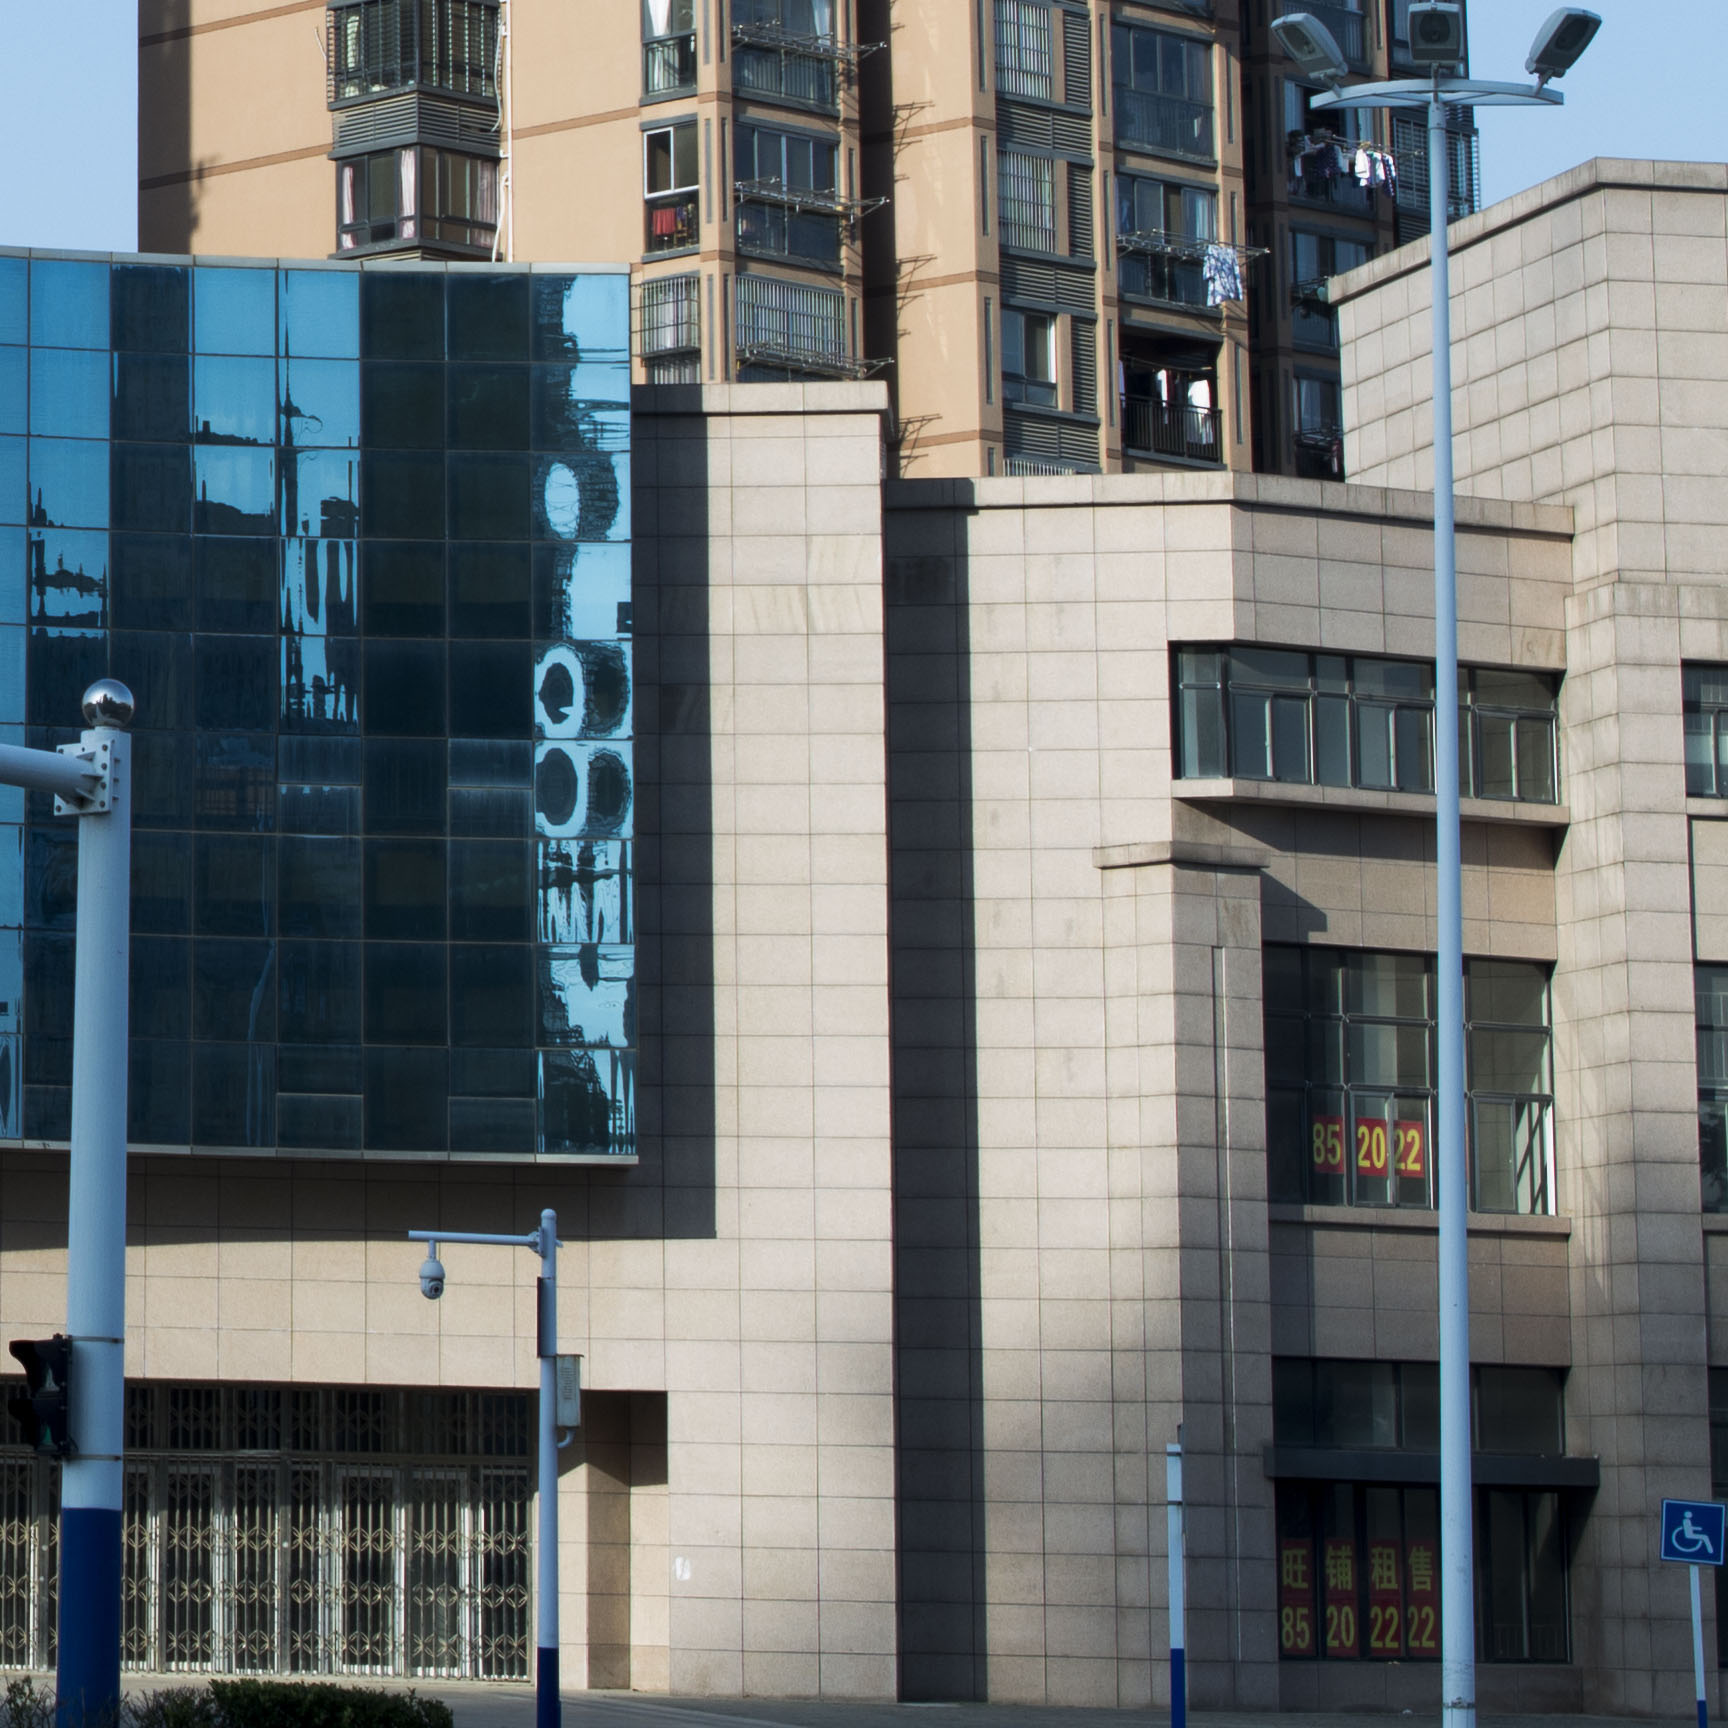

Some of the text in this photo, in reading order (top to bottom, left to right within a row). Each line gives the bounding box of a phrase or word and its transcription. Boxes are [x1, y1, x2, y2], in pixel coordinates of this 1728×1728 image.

[1313, 1122, 1421, 1171] 85 20 22
[1282, 1545, 1433, 1591] 旺铺租售
[1281, 1605, 1435, 1649] 85 20 22 22
